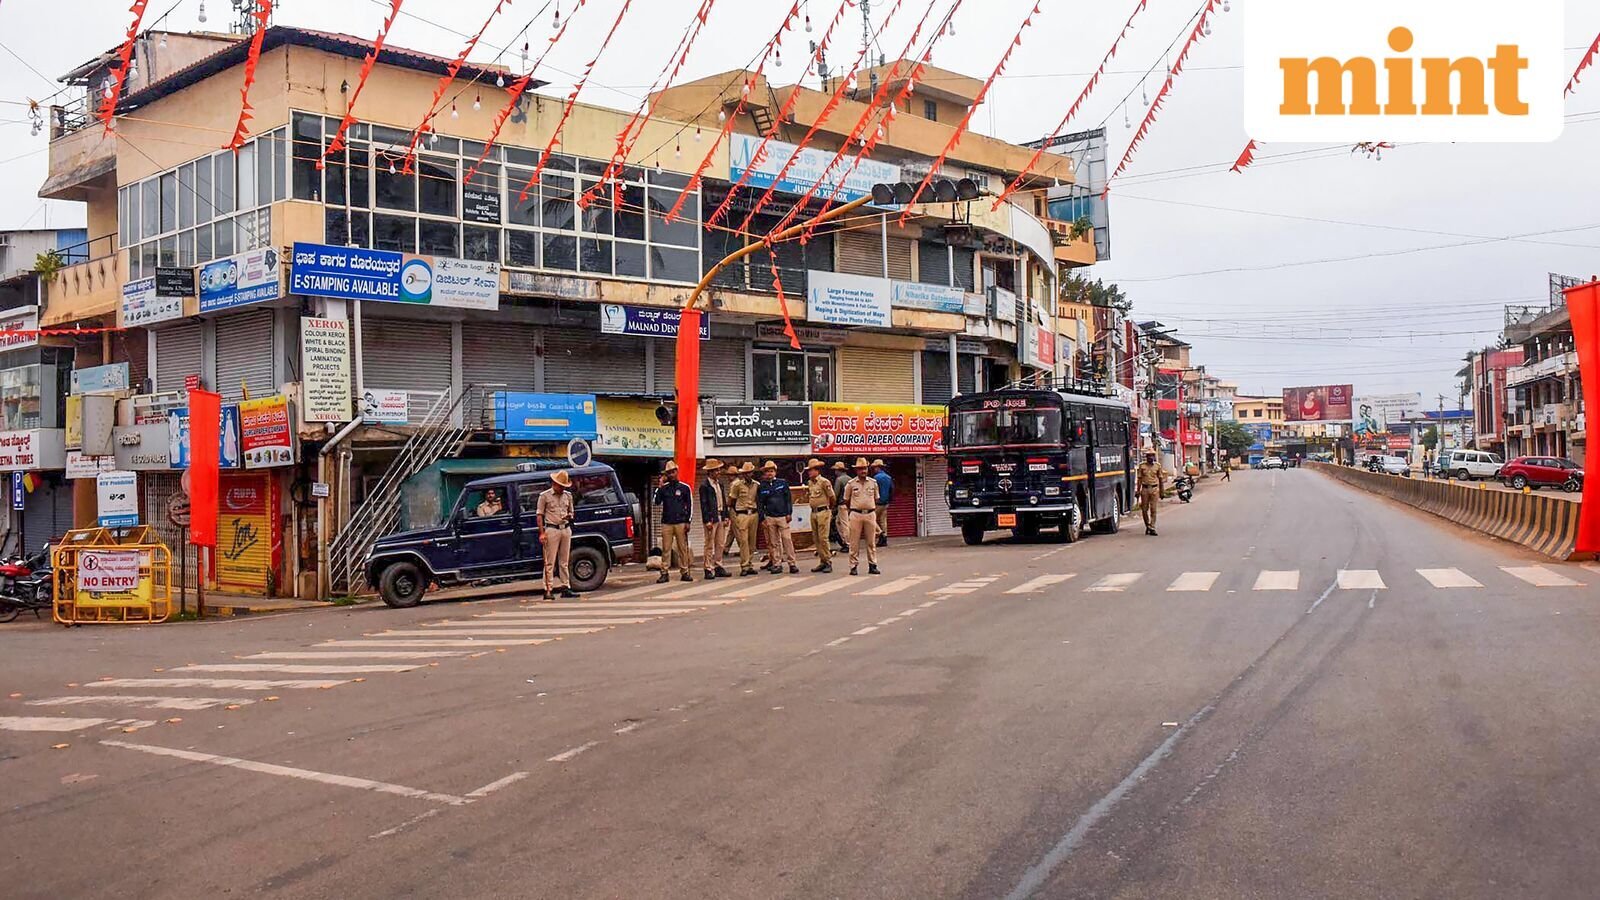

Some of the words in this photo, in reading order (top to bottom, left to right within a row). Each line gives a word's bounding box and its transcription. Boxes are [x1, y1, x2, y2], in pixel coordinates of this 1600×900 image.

[793, 184, 821, 198] JUMO
[320, 253, 347, 268] ಕಾಗದ
[294, 274, 349, 294] E-STAMPING
[352, 280, 399, 297] AVAILABLE
[473, 277, 496, 289] ಸೇವಾ
[827, 287, 841, 295] Large
[815, 306, 833, 314] Maping
[308, 319, 344, 330] XEROX
[628, 320, 659, 332] MALNAD
[305, 346, 324, 354] SPIRAL
[325, 347, 346, 355] BINDING
[312, 363, 340, 371] PROJECTS
[776, 418, 782, 426] &
[864, 410, 904, 432] ಪೇಪರ್
[605, 425, 636, 433] TANISHKA
[717, 428, 762, 438] GAGAN
[835, 434, 865, 444] DURGA
[867, 434, 893, 444] PAPER
[894, 434, 933, 445] COMPANY
[15, 454, 34, 465] STORES
[15, 472, 21, 489] P
[84, 577, 98, 586] NO
[102, 576, 135, 586] ENTRY
